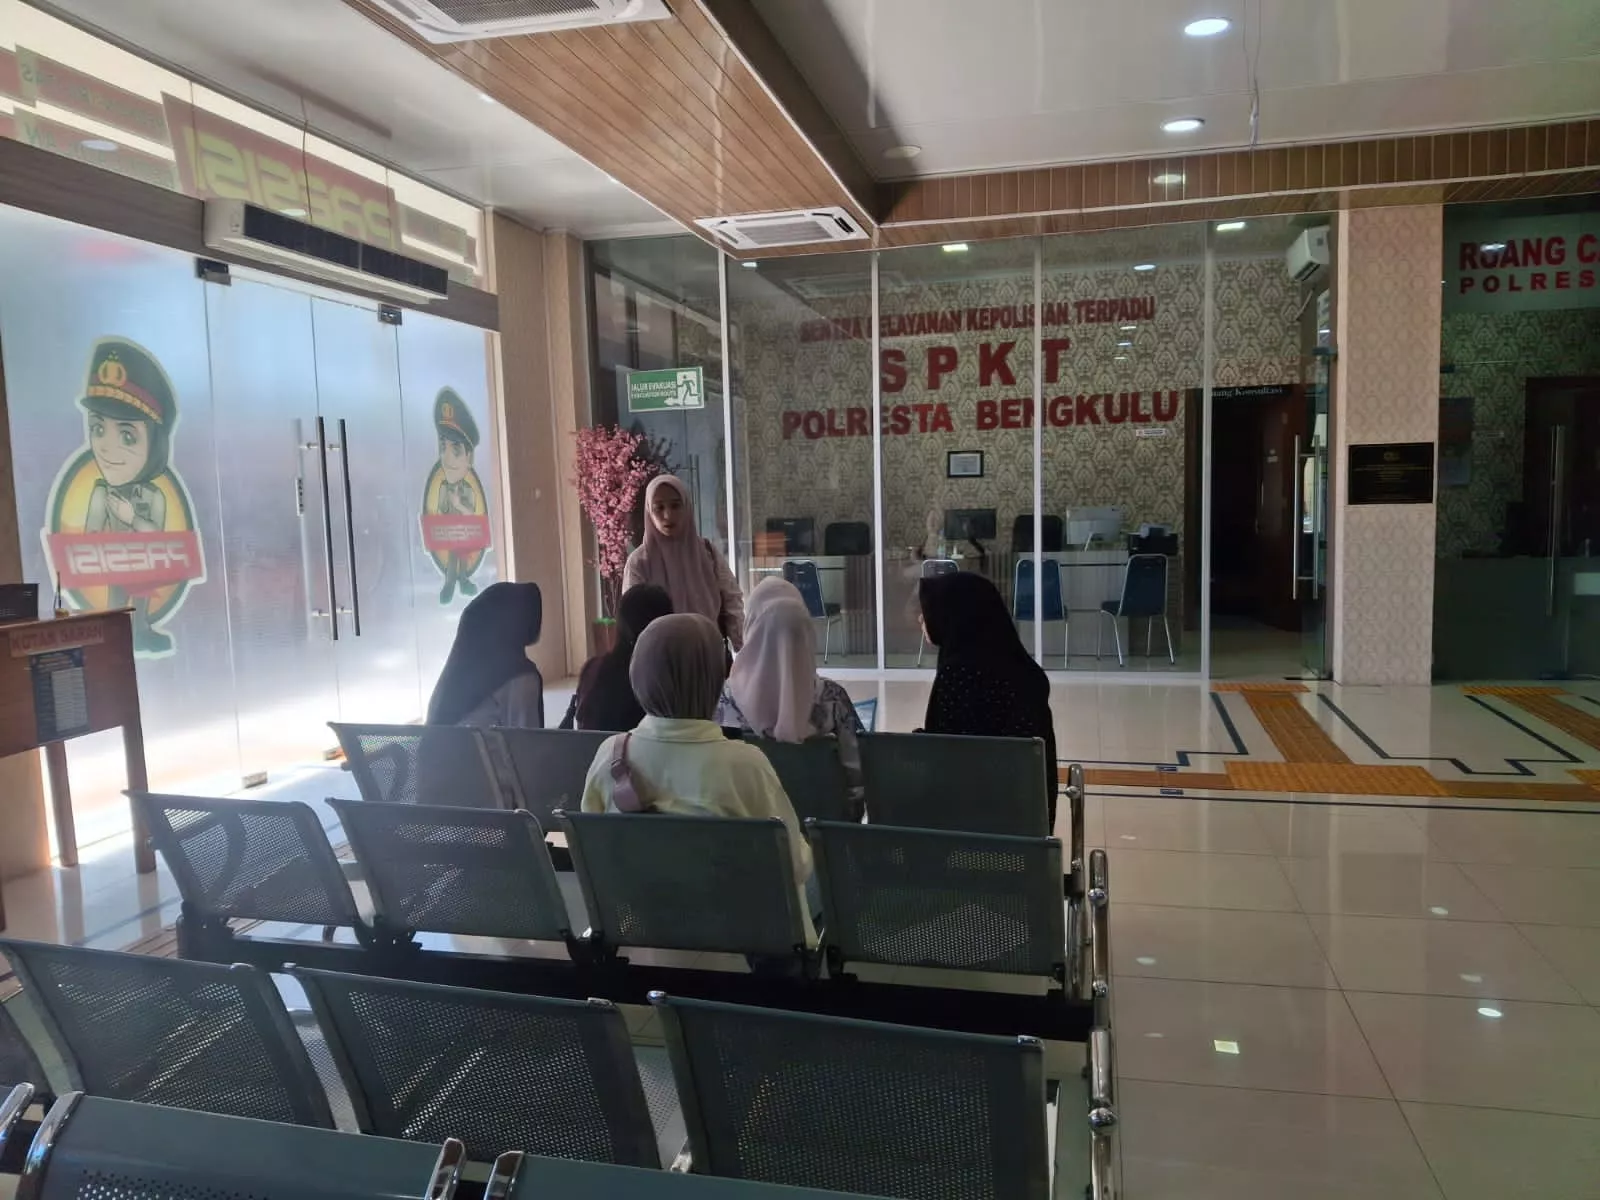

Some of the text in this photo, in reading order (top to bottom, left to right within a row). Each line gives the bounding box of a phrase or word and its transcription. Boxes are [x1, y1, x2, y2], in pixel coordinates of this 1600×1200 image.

[1459, 233, 1600, 271] RUANG C
[1460, 270, 1596, 295] POLRES
[967, 302, 1069, 331] KEPOLISIAN
[1074, 296, 1155, 324] TERPADU
[782, 390, 1179, 440] POLRESTA BENGKULU
